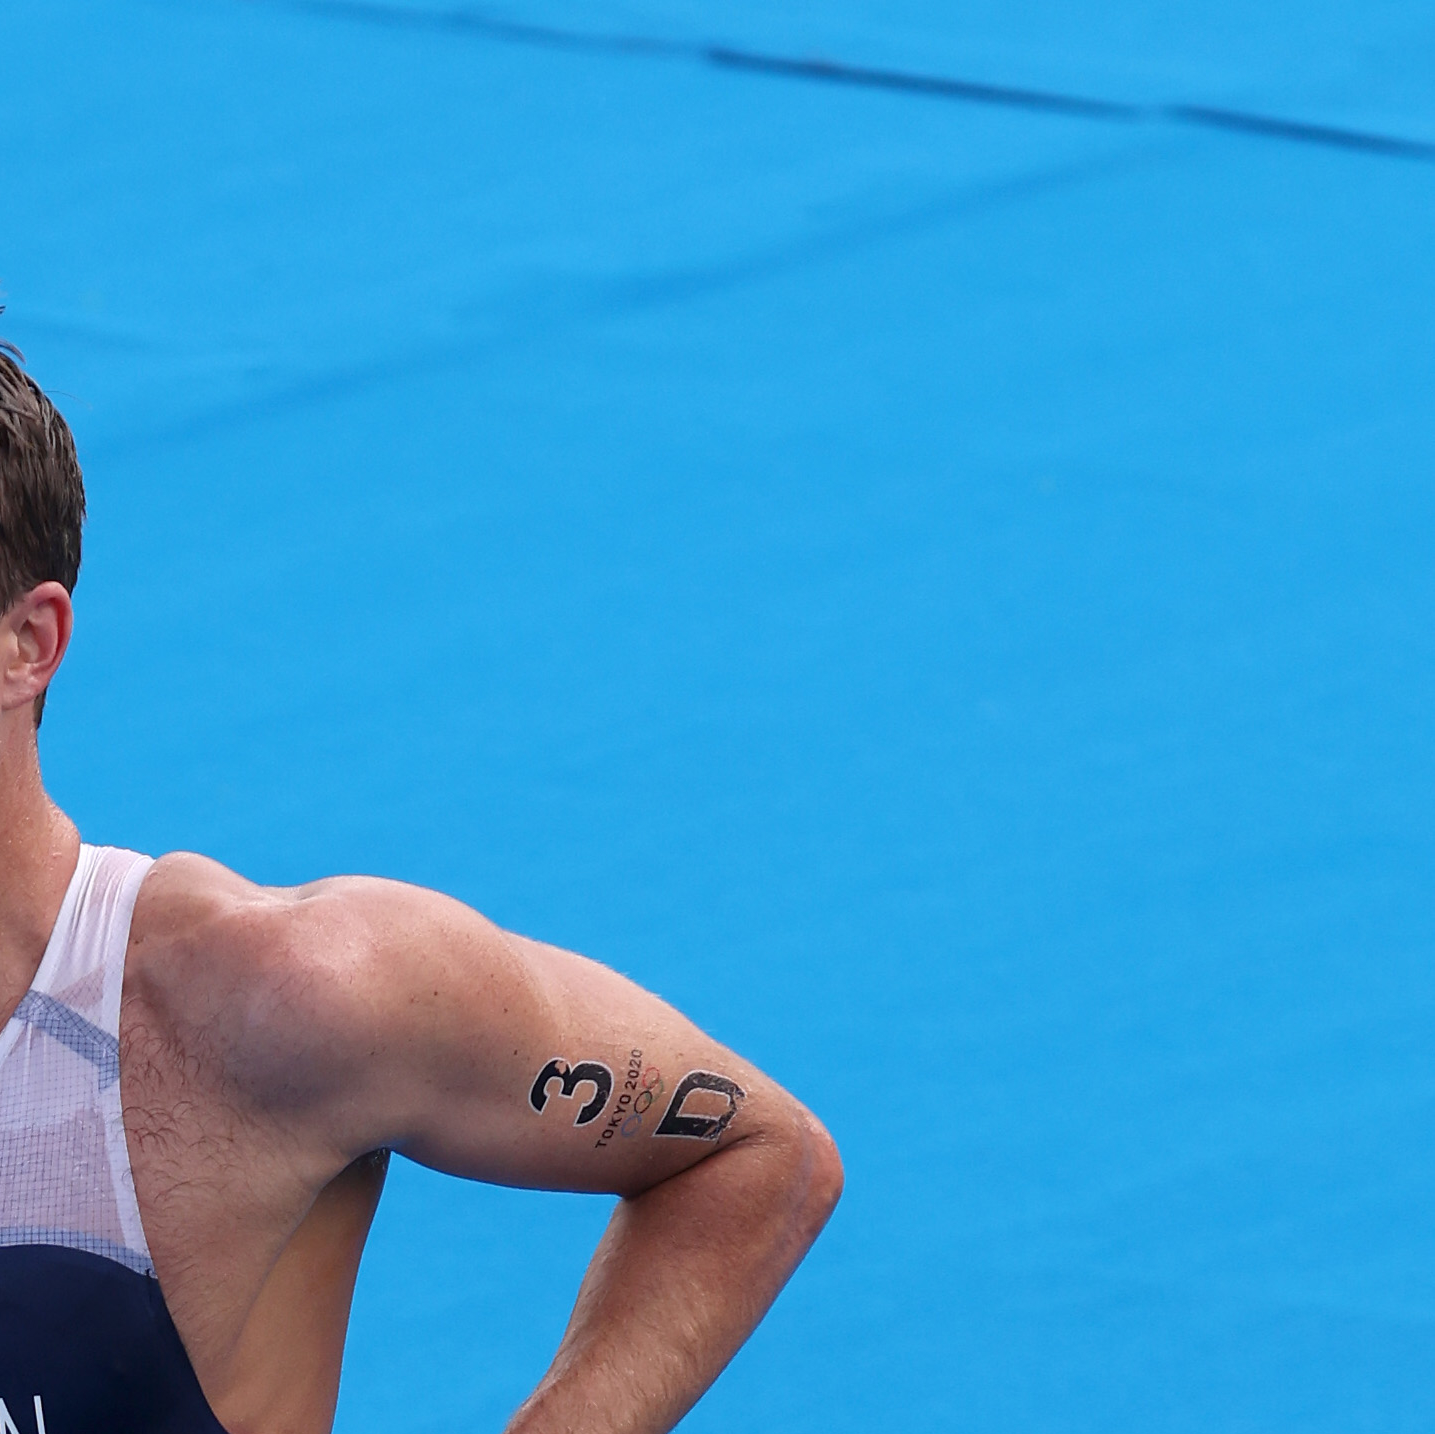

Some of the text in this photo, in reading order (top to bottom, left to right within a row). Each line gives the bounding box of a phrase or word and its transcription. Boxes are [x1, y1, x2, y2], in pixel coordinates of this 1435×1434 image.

[528, 1057, 614, 1128] 3
[595, 1048, 643, 1149] TOKYO 2020
[652, 1069, 747, 1142] D
